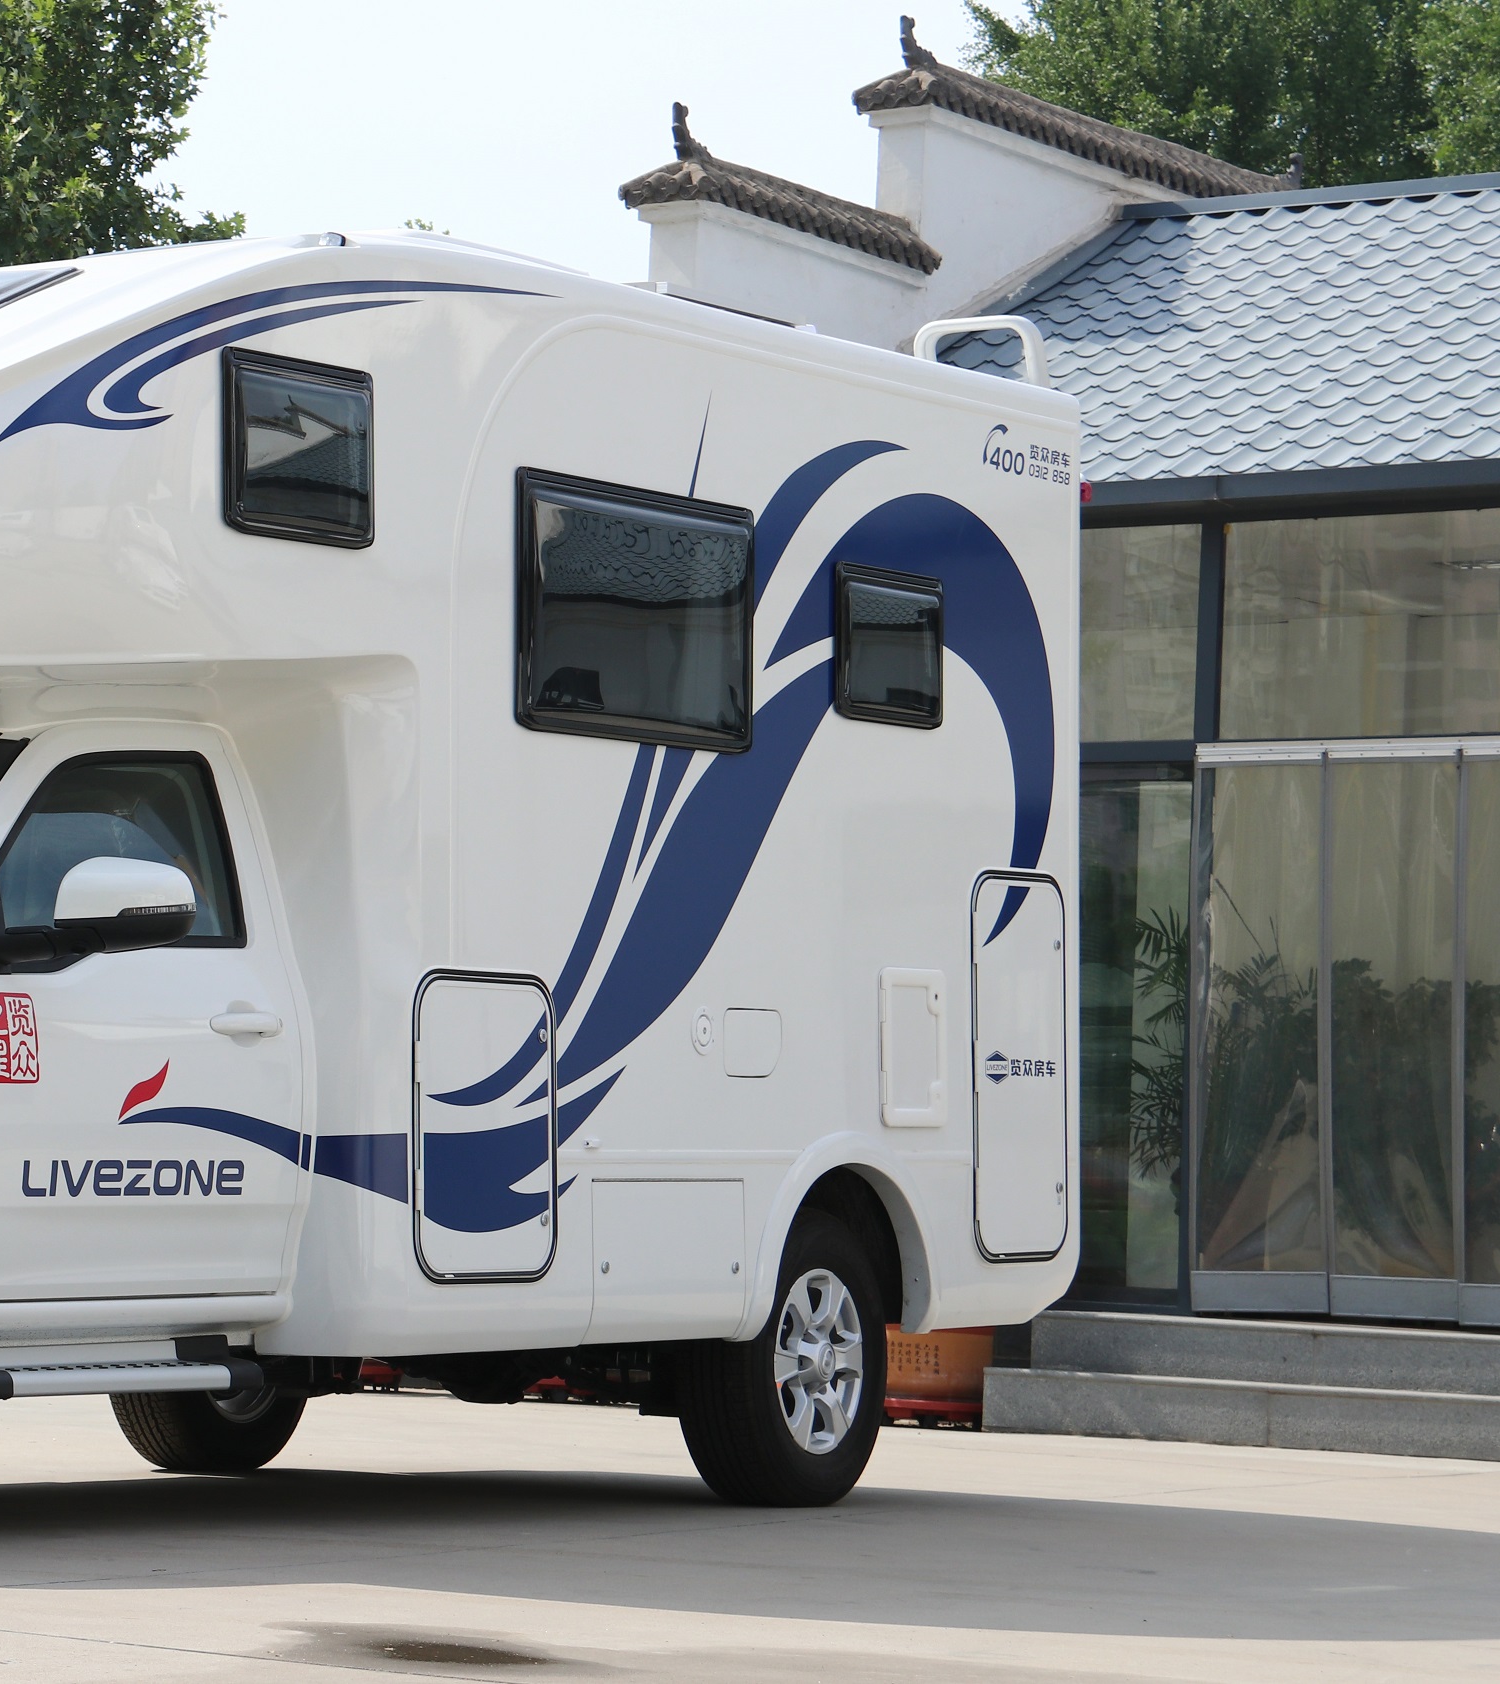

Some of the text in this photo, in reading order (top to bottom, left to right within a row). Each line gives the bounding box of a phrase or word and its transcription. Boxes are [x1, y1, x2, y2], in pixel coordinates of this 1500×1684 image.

[989, 446, 1025, 476] 400
[1029, 444, 1071, 468] 览众房车
[1028, 463, 1071, 486] 0312 858
[8, 998, 36, 1078] 览众
[1010, 1058, 1056, 1077] 览众房车
